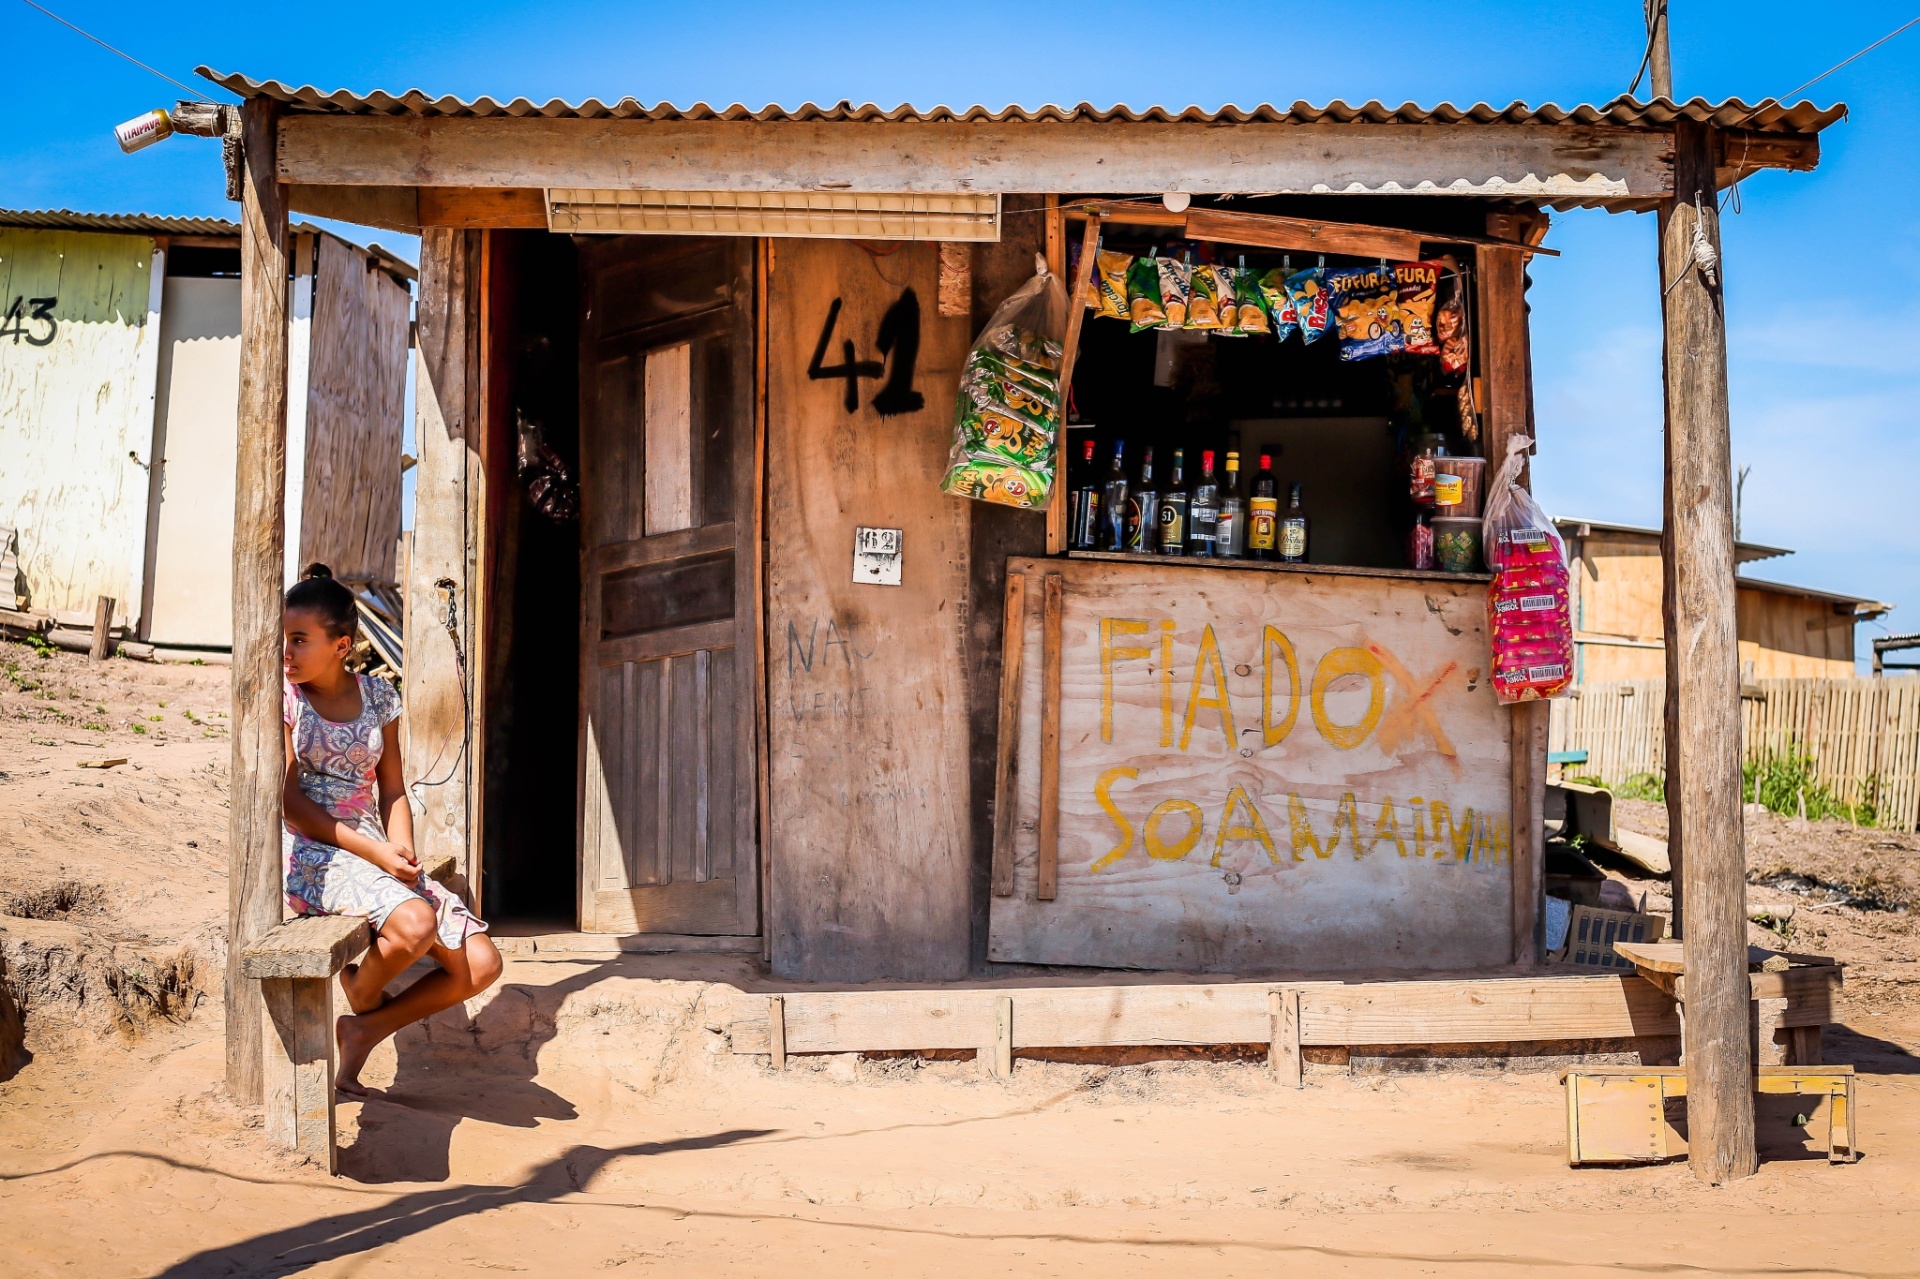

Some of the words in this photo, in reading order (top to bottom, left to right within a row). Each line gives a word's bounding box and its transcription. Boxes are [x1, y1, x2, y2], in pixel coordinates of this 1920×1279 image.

[1395, 267, 1436, 284] FURA
[0, 295, 58, 347] 43
[807, 286, 925, 417] 41
[1161, 510, 1172, 523] 51
